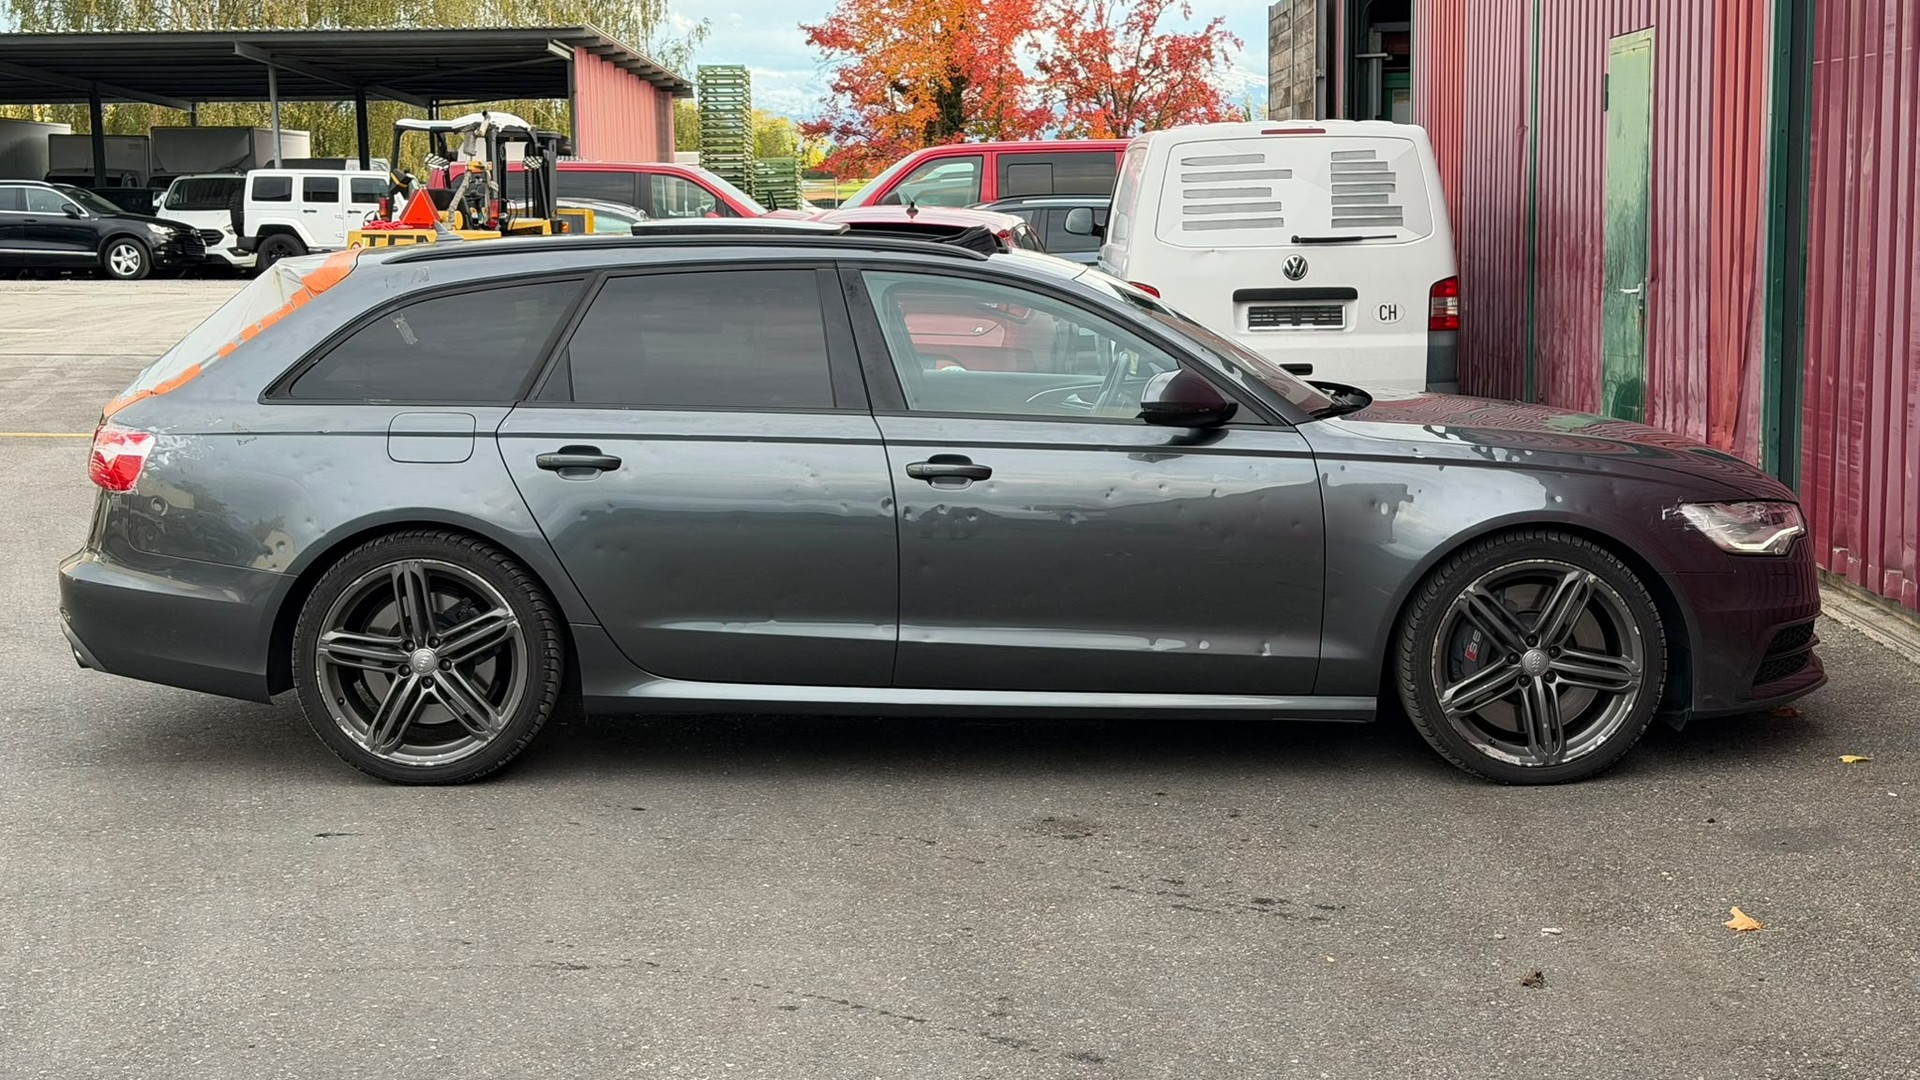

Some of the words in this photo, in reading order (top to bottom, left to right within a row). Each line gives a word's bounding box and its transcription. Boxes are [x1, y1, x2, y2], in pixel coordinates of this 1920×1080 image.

[1282, 254, 1308, 281] VW
[1378, 304, 1397, 321] CH
[1468, 630, 1481, 656] S6
